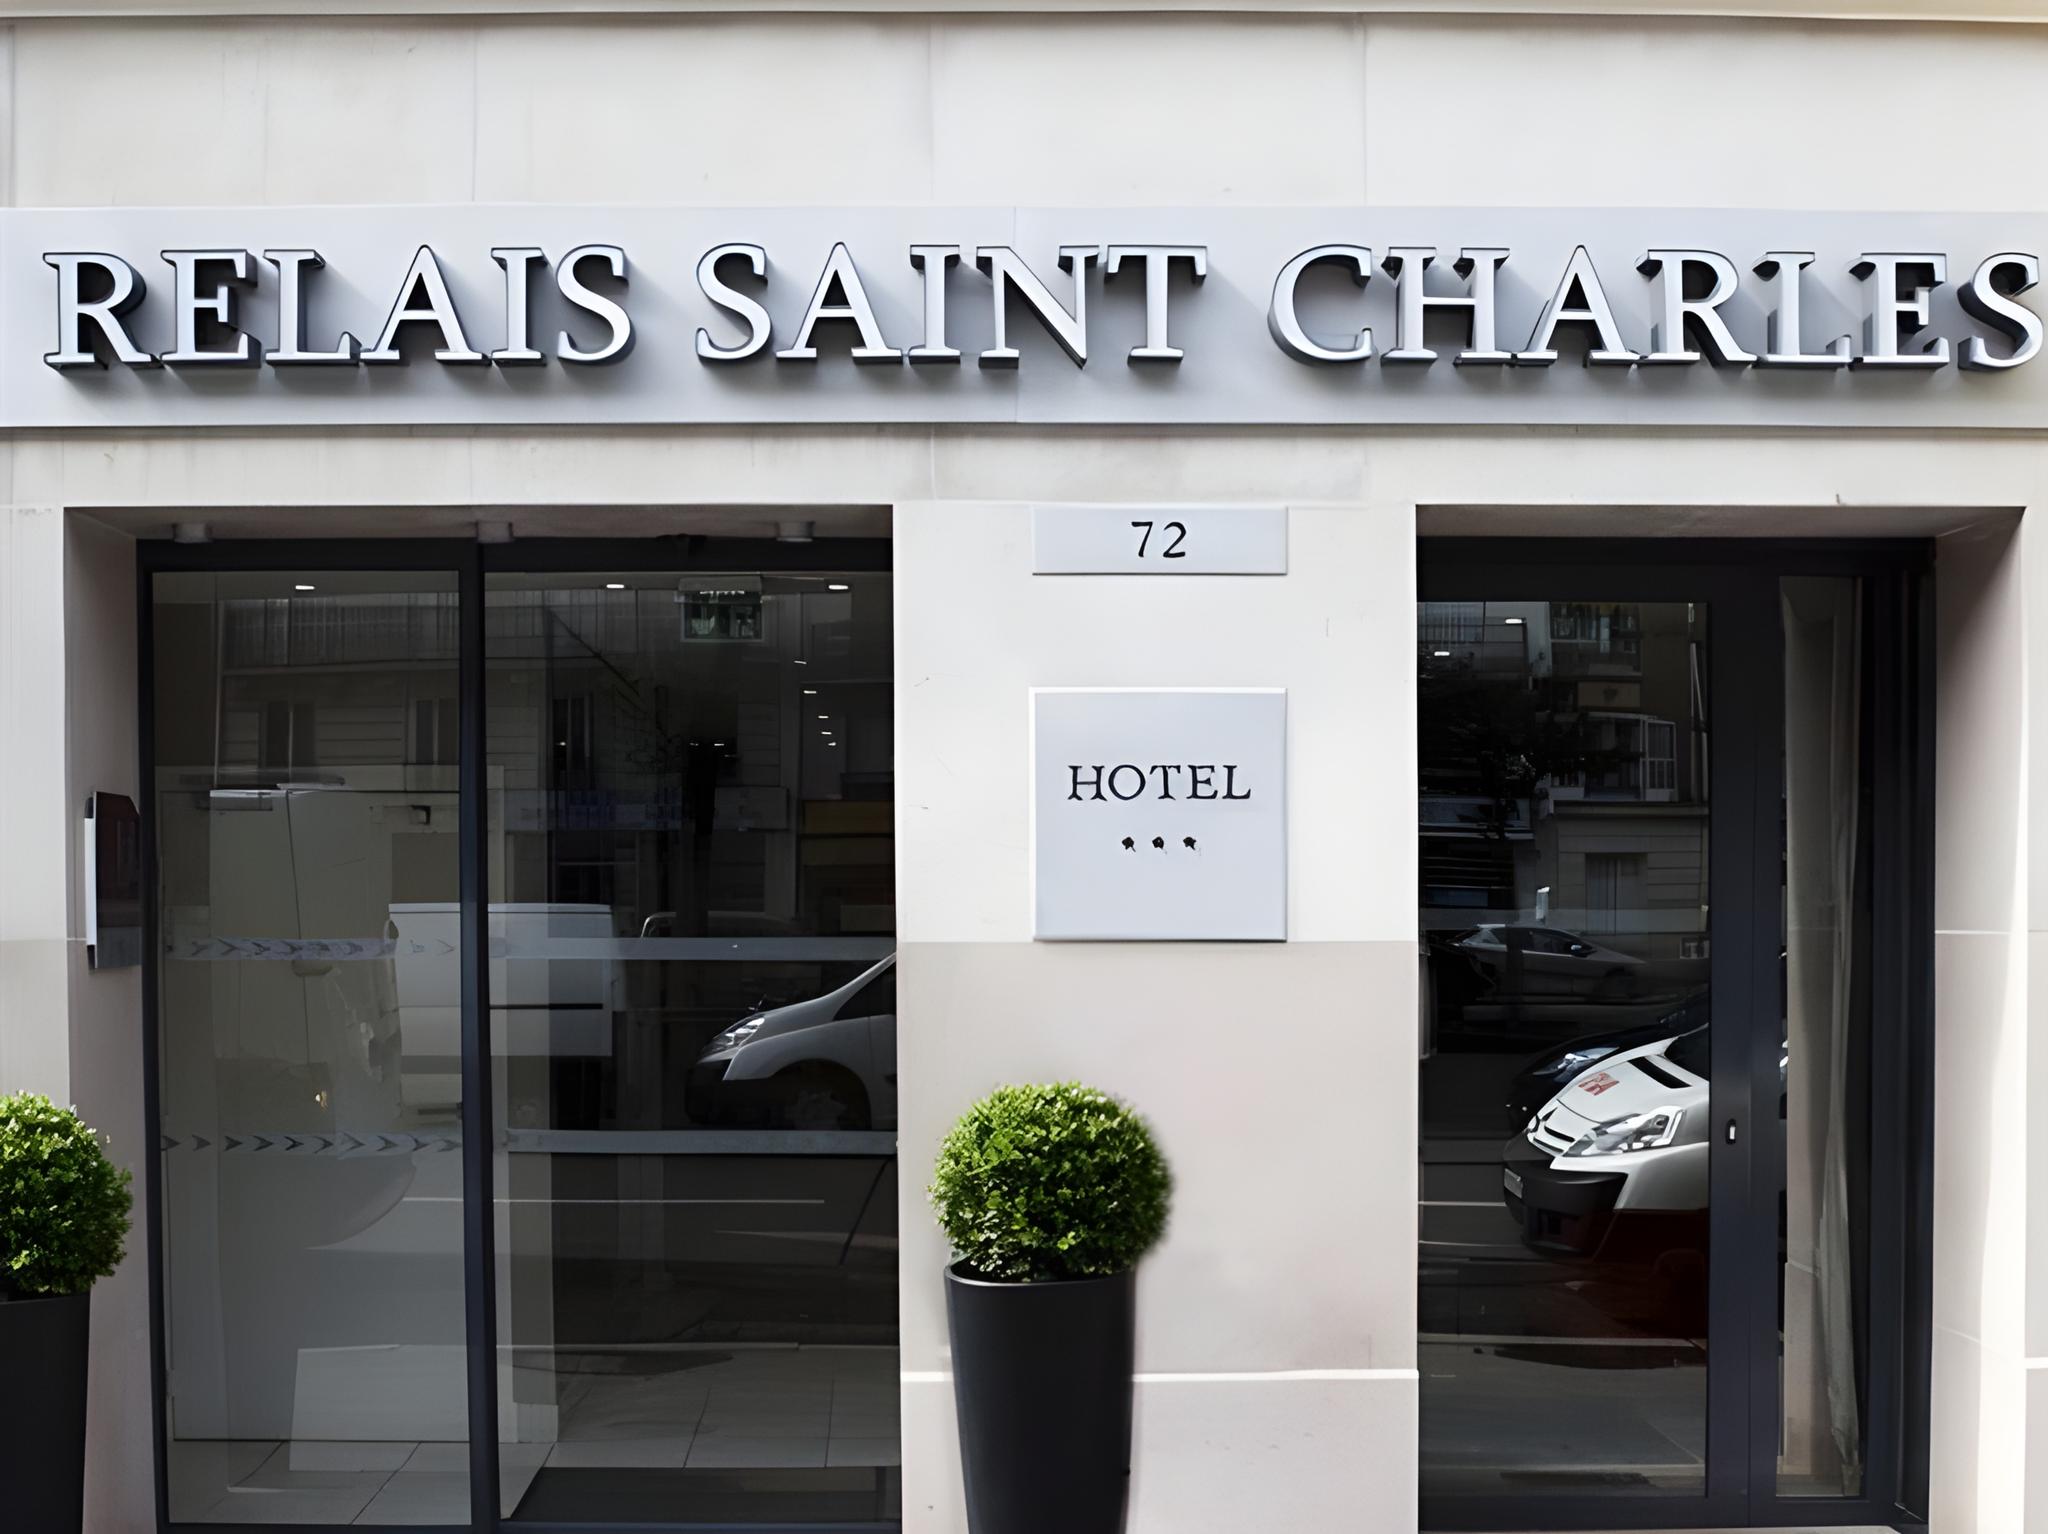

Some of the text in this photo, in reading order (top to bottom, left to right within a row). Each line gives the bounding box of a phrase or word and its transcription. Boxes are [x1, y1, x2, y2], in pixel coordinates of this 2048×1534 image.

[42, 241, 2045, 371] RELAIS SAINT CHARLES
[1131, 521, 1187, 558] 72
[1067, 764, 1252, 801] HOTEL
